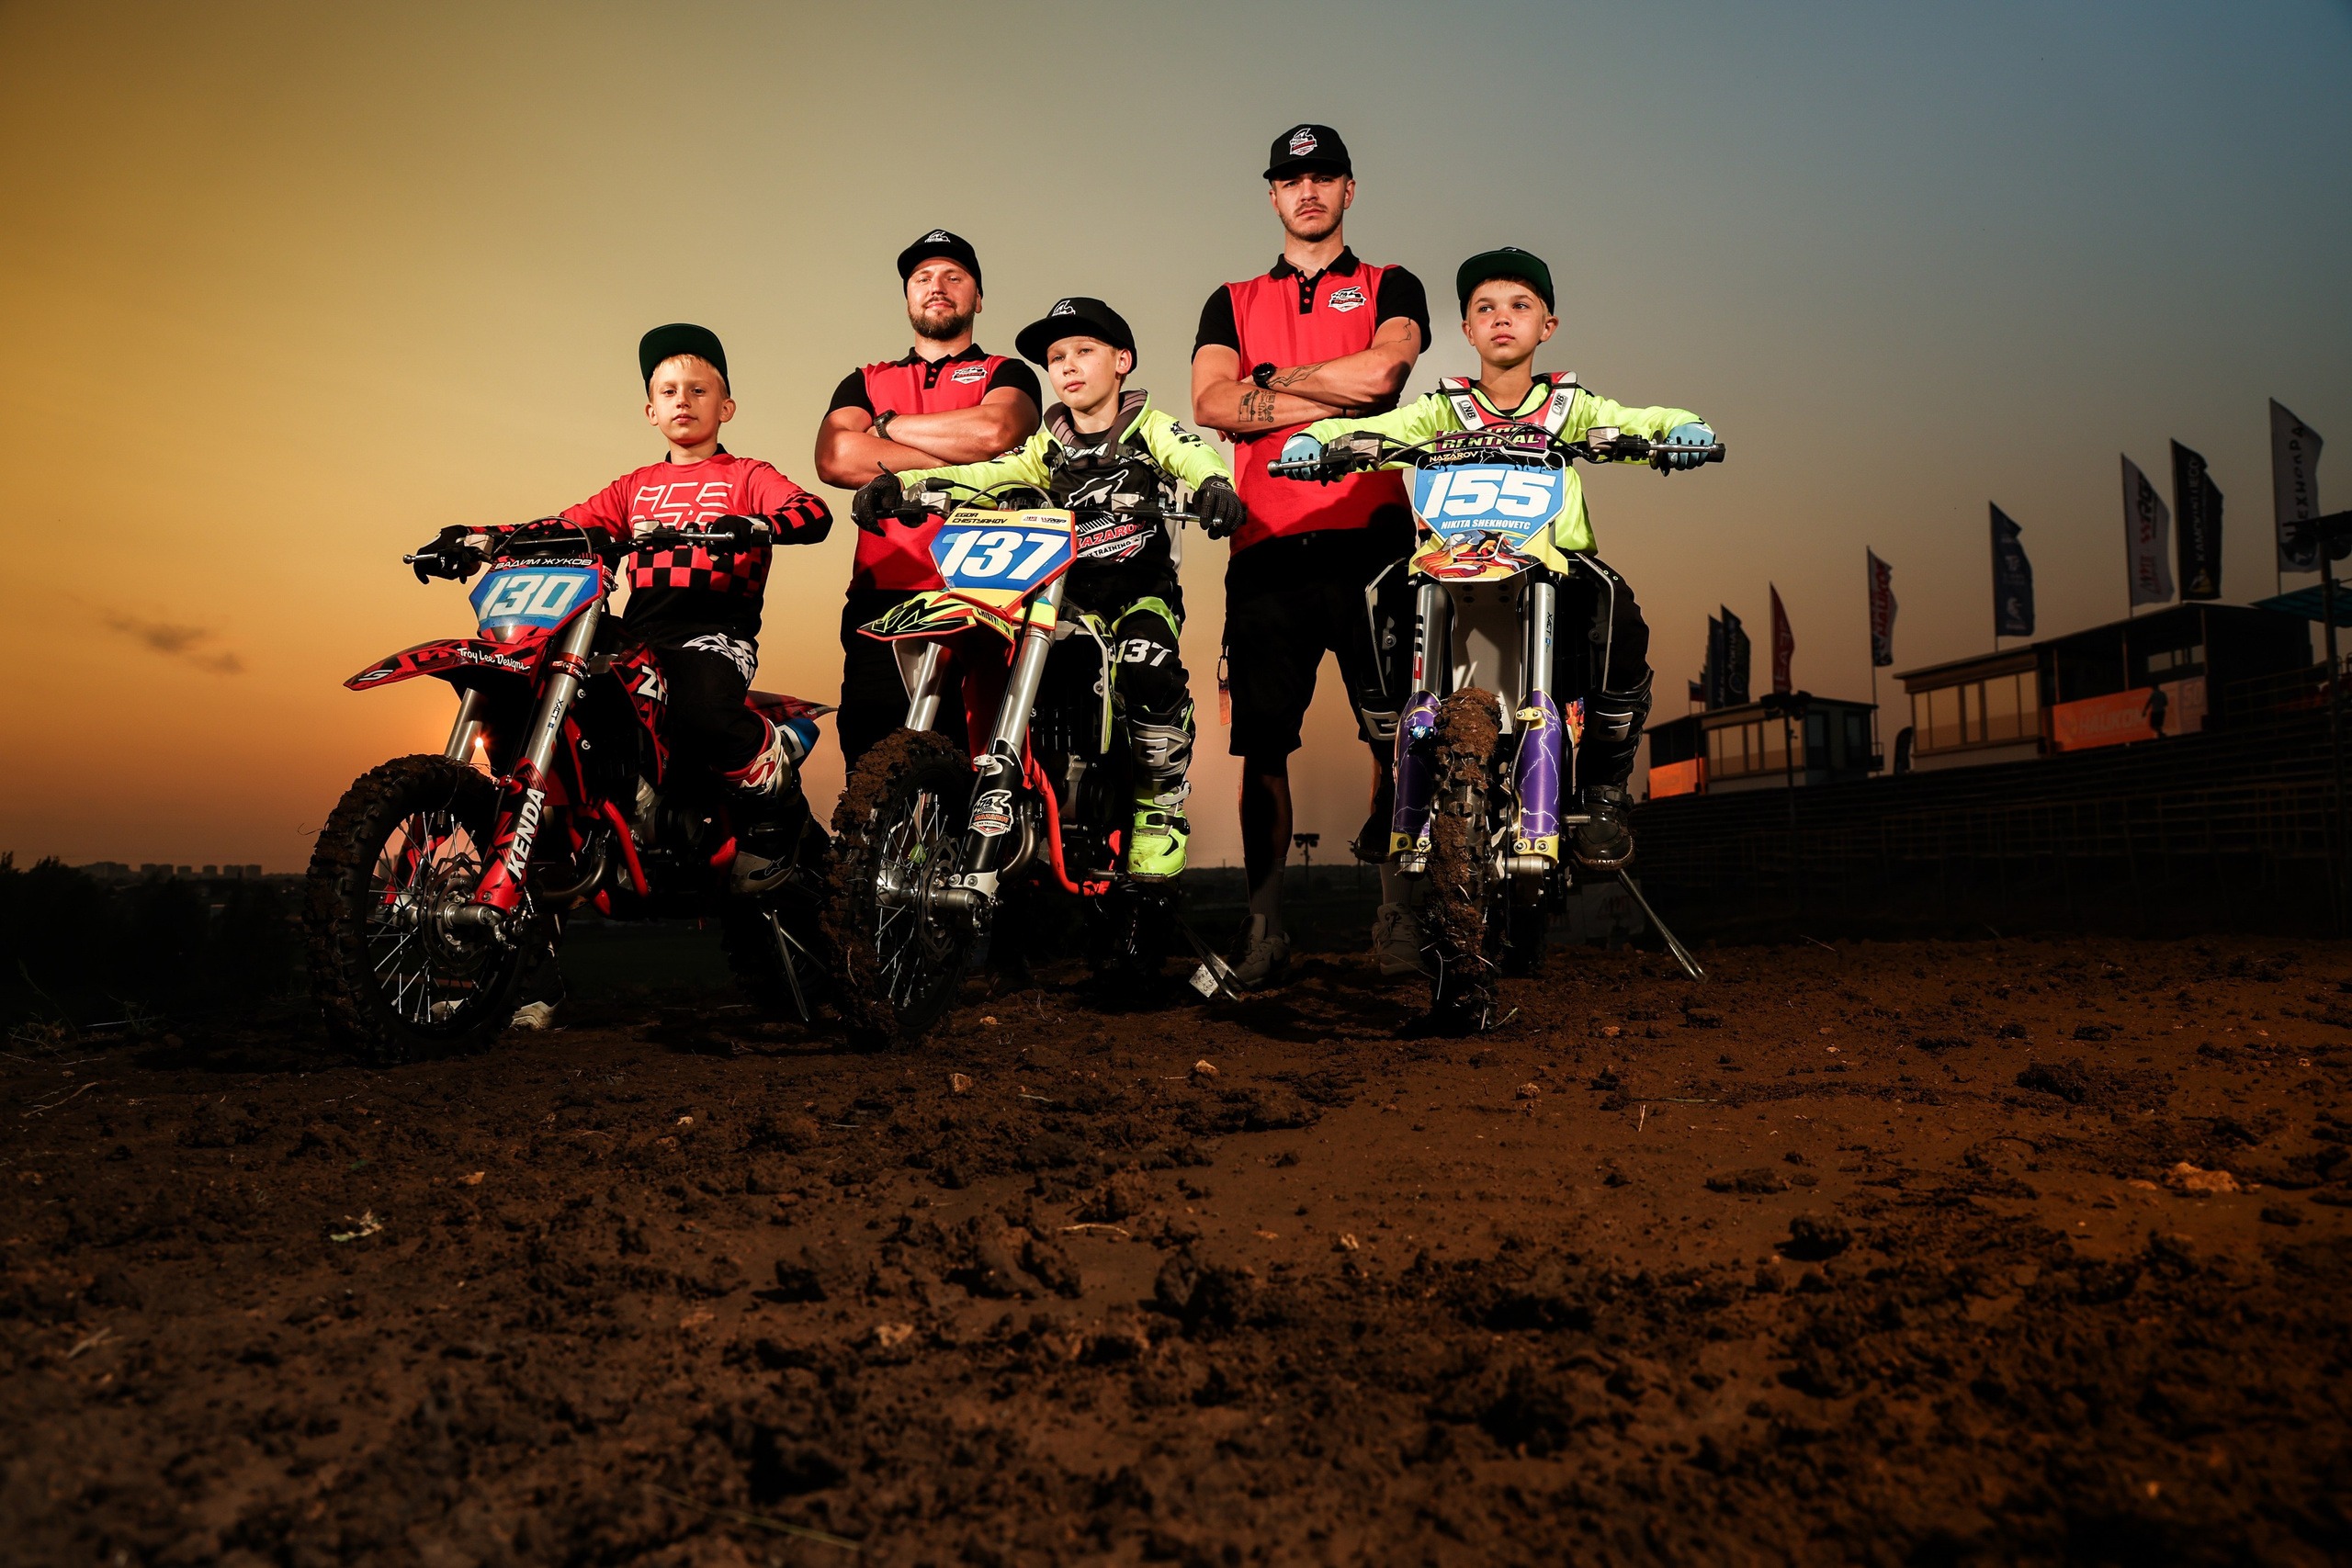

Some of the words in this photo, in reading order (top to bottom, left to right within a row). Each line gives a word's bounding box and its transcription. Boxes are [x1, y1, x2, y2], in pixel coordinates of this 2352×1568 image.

[1429, 450, 1479, 463] NAZAROV
[632, 481, 733, 513] ACE
[1422, 469, 1557, 519] 155
[1441, 519, 1471, 530] NIKITA
[1472, 519, 1532, 530] SHEKHOVETC
[940, 530, 1069, 581] 137
[1094, 540, 1131, 557] TRAINING
[494, 558, 540, 570] ВАДИМ
[481, 574, 590, 617] 130
[457, 648, 479, 663] Troy
[479, 649, 496, 663] Lee
[496, 653, 531, 672] Designs
[507, 787, 546, 880] KENDA
